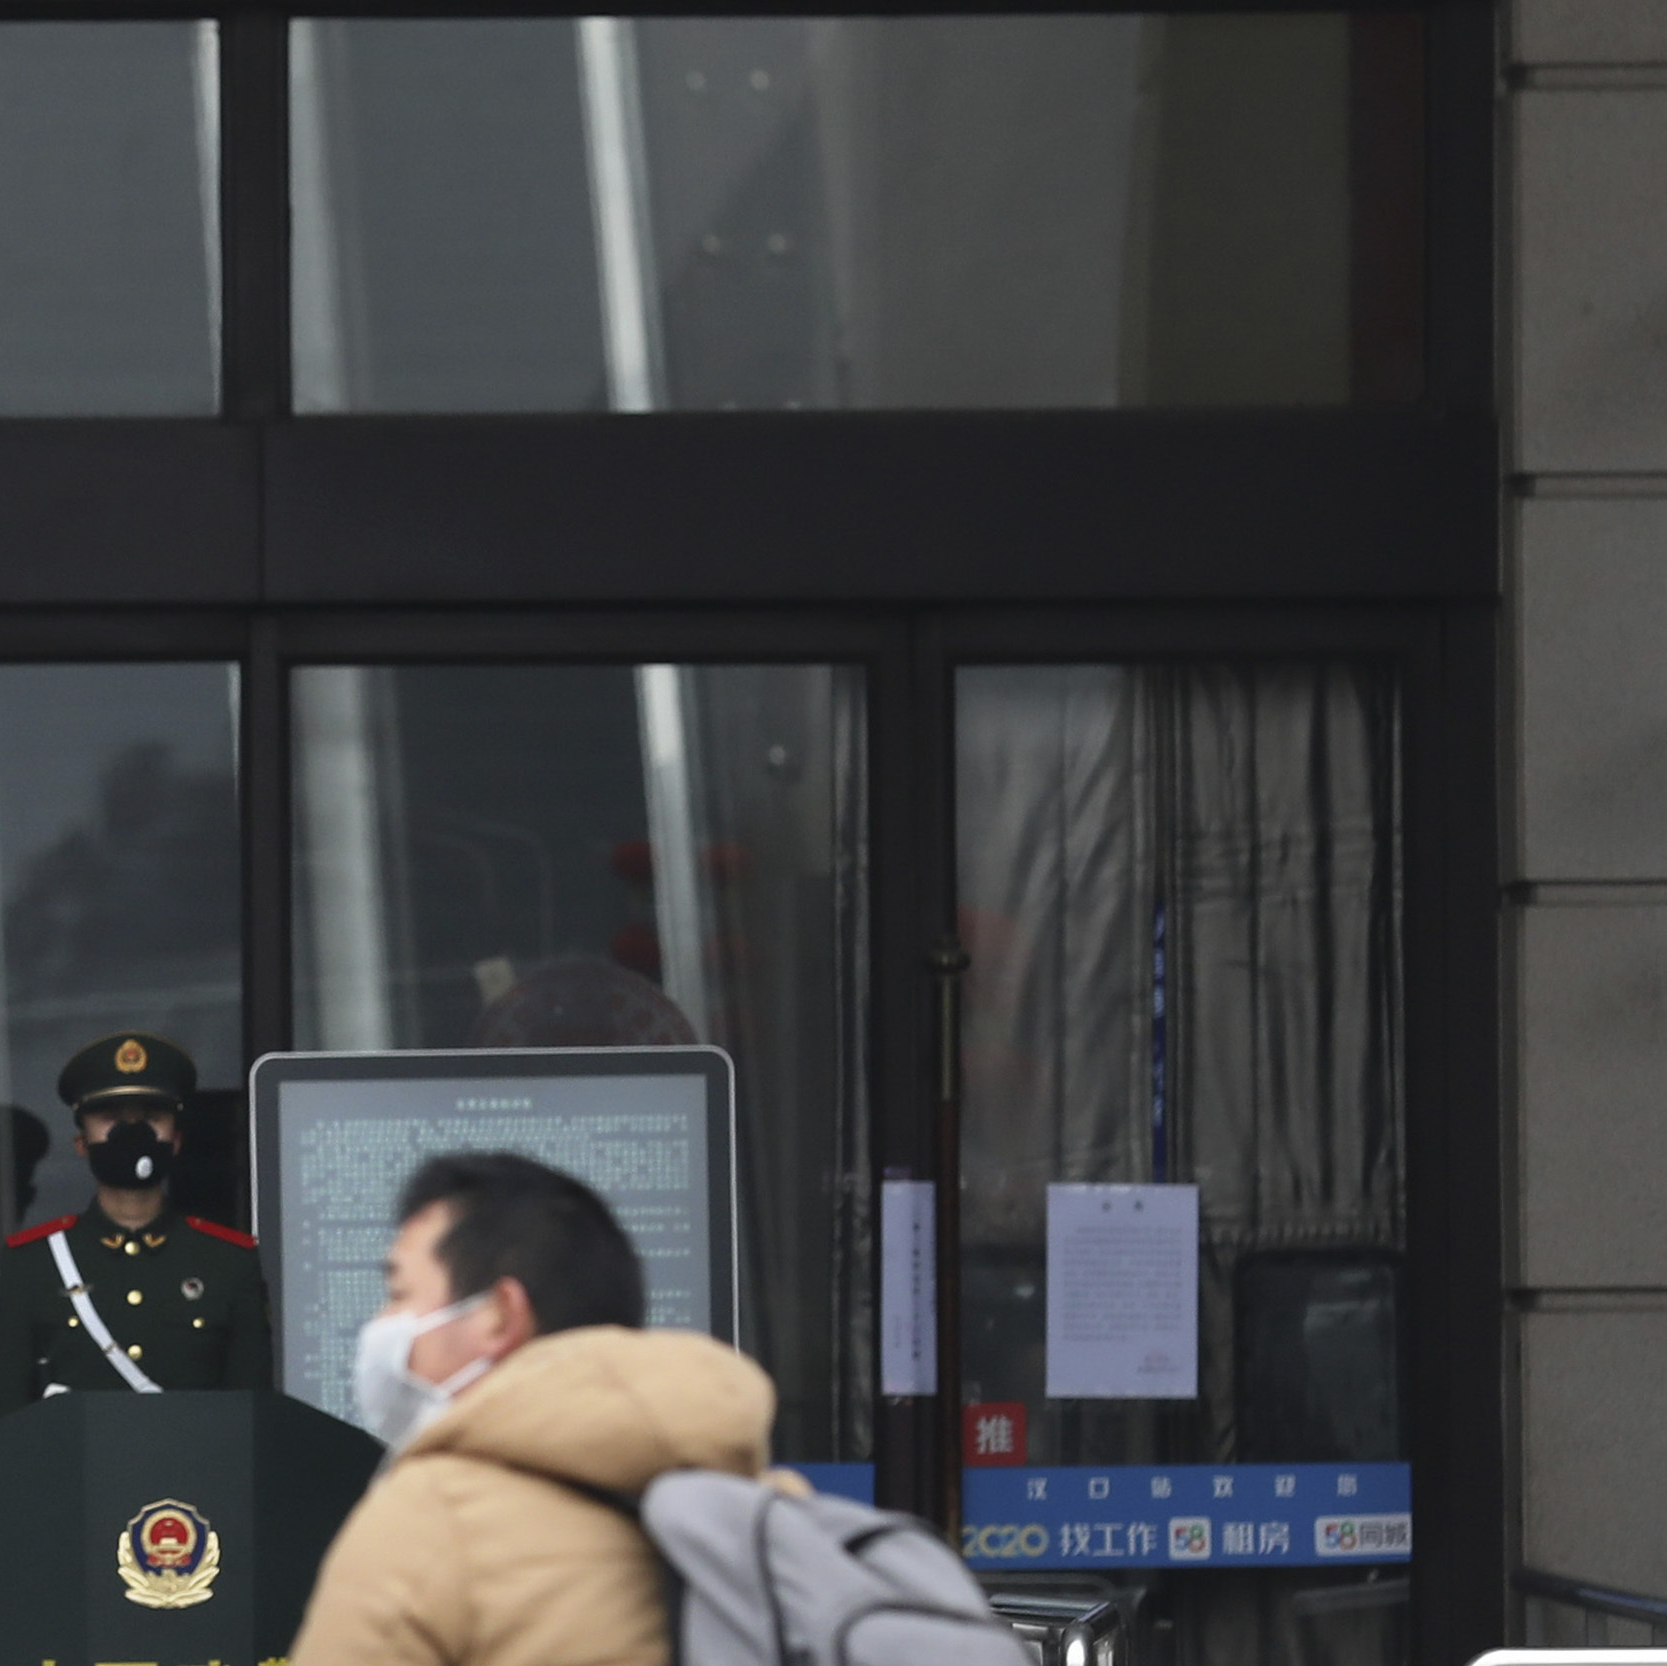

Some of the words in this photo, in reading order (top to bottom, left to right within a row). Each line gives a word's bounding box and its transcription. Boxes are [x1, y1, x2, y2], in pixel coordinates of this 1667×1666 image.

[975, 1414, 1014, 1456] 推
[962, 1523, 1050, 1558] 2020
[1060, 1521, 1158, 1557] 找工作
[1222, 1520, 1290, 1555] 租房
